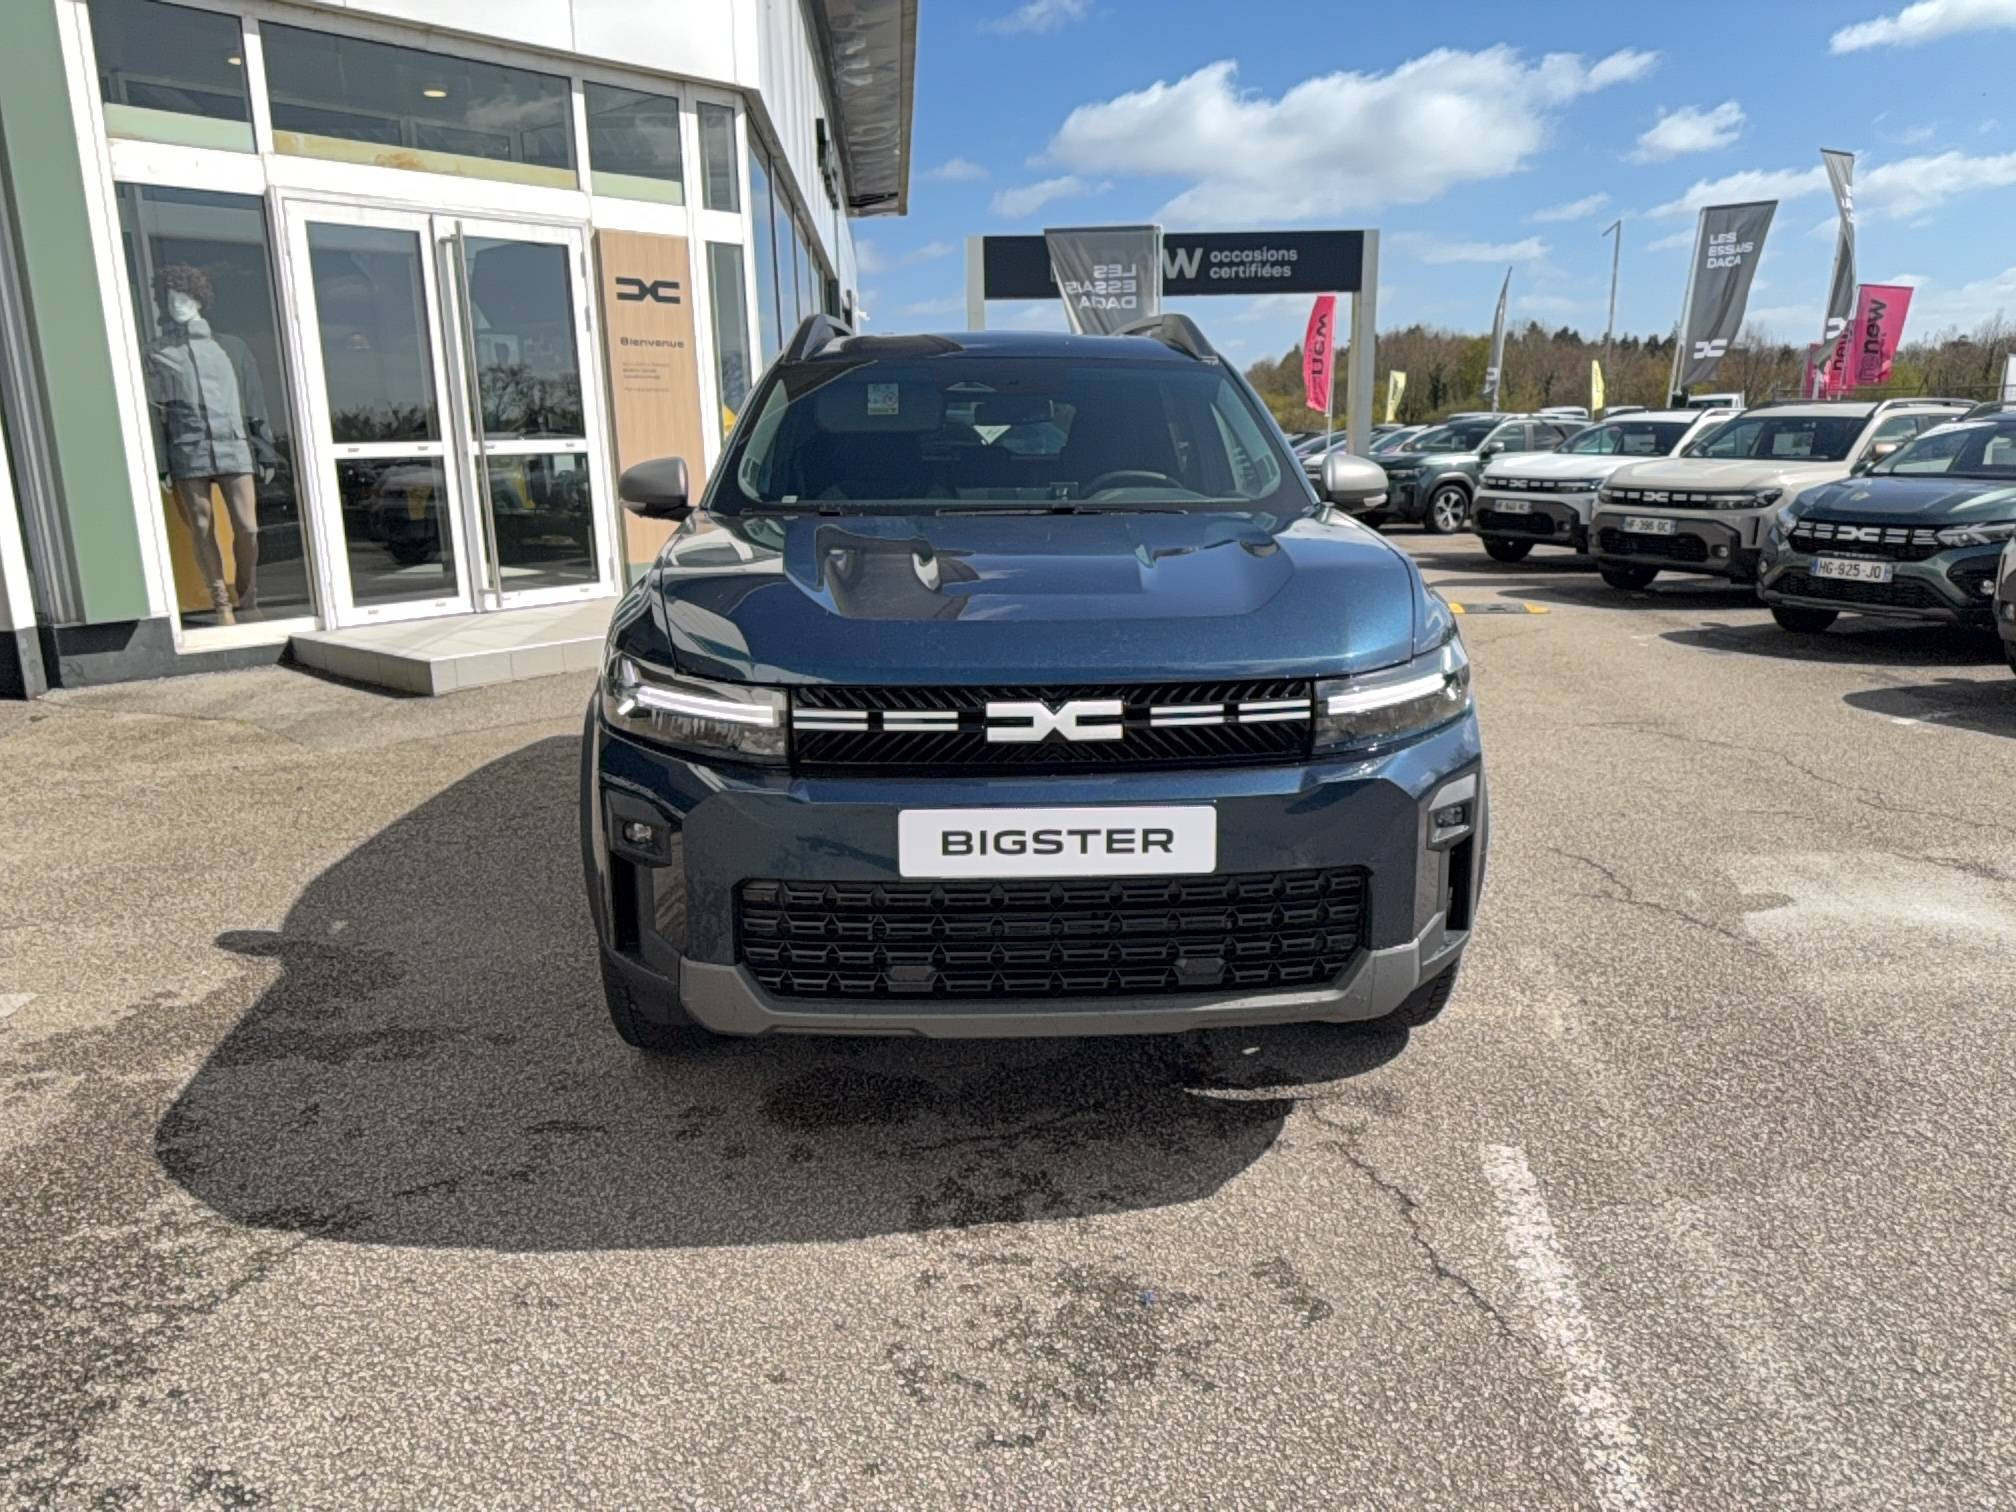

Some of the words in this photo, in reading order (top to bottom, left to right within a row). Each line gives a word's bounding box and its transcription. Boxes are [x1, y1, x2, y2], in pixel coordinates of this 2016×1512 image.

[1209, 246, 1298, 263] occasions
[1209, 263, 1292, 279] certifiées
[620, 336, 685, 349] Bienvenue
[941, 828, 1175, 856] BIGSTER
